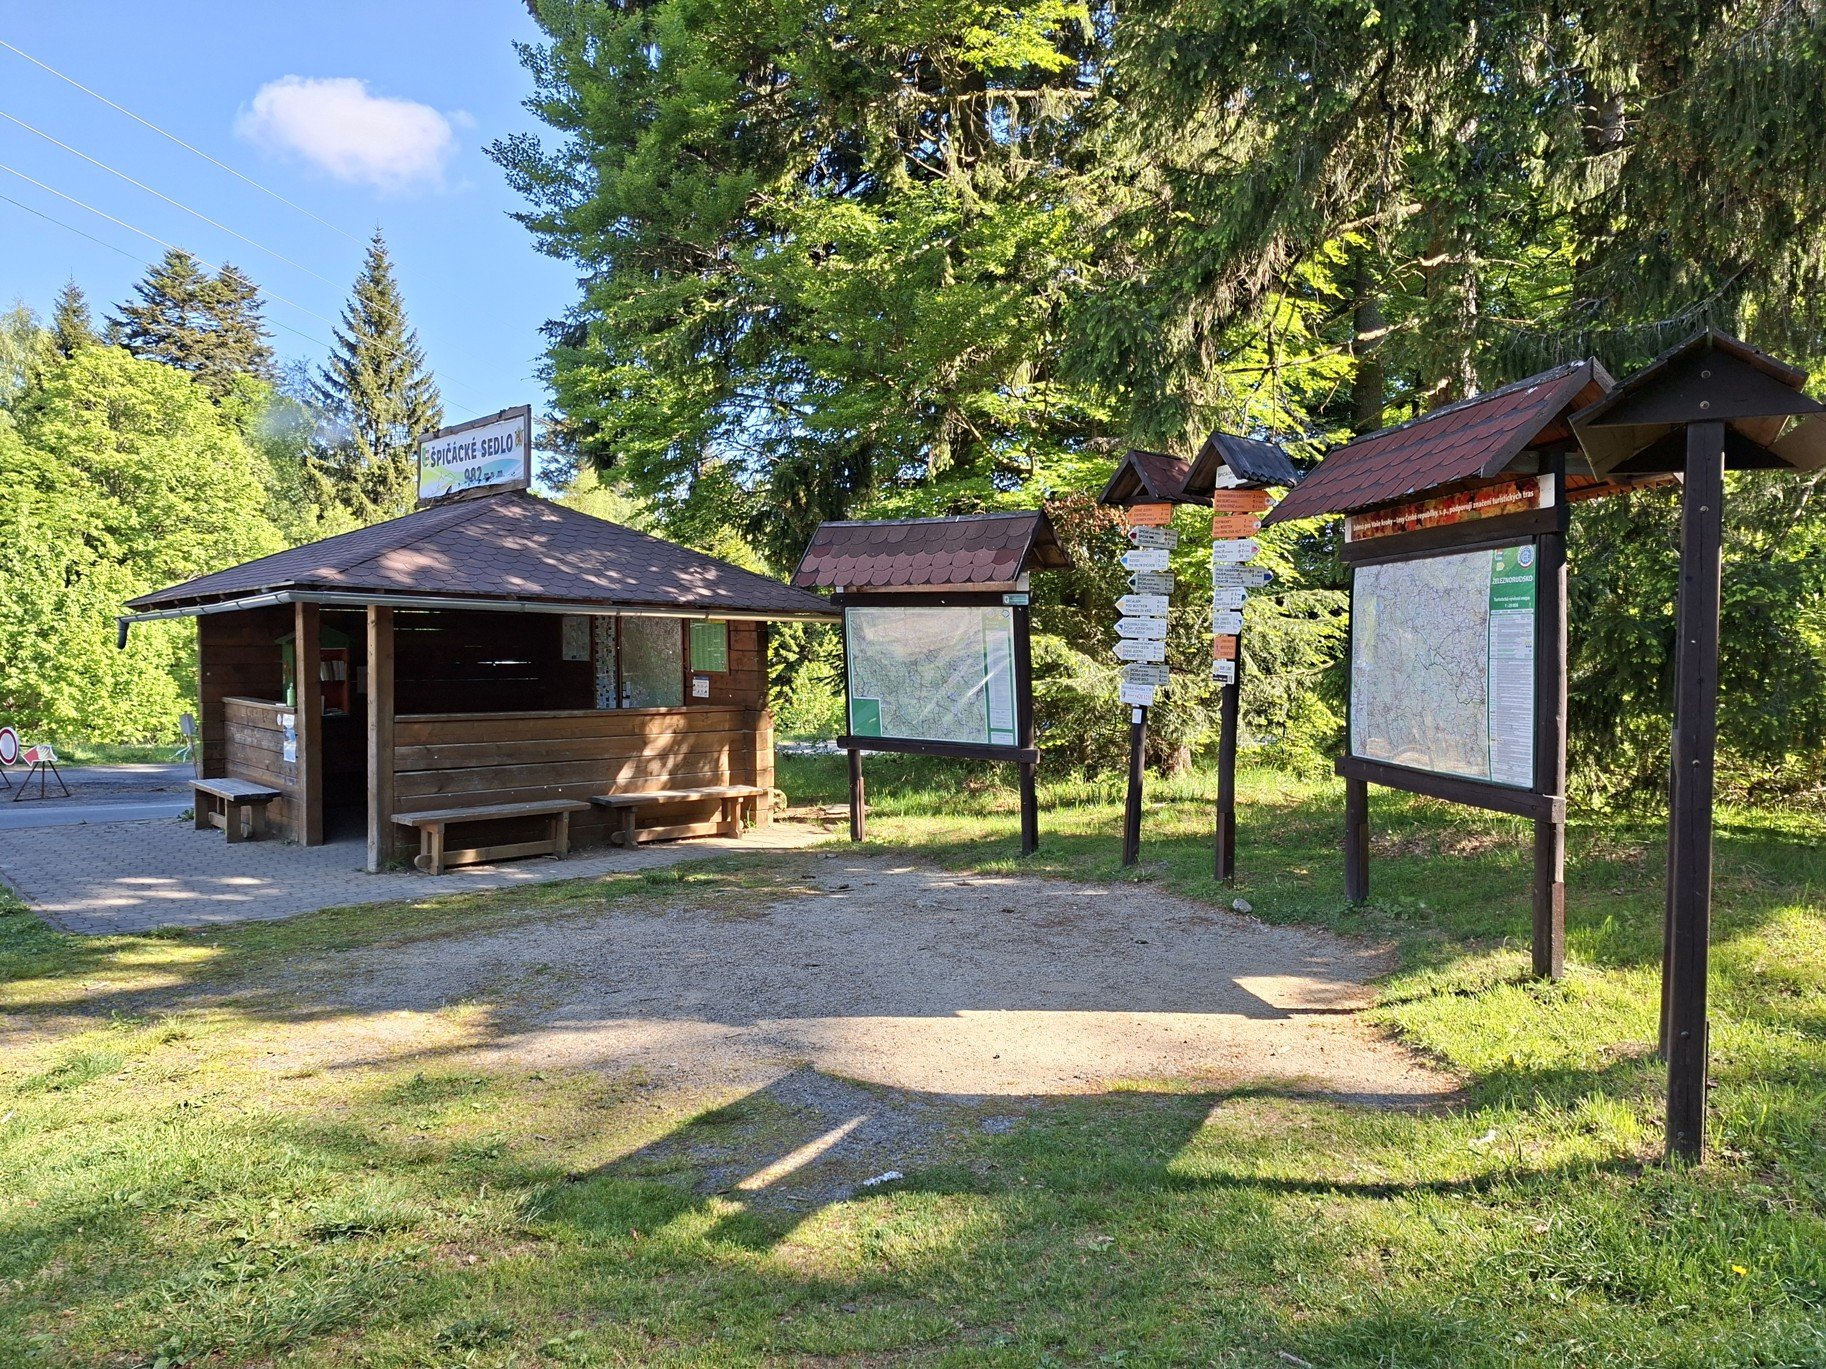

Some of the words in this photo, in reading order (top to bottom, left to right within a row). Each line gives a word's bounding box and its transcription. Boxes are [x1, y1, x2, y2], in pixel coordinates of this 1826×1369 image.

[430, 437, 477, 468] ŠPIČÁCKÉ
[481, 433, 513, 458] SEDLO
[464, 465, 482, 482] 982
[1473, 497, 1492, 509] značení
[1492, 491, 1522, 504] turistických
[1523, 490, 1534, 499] tras
